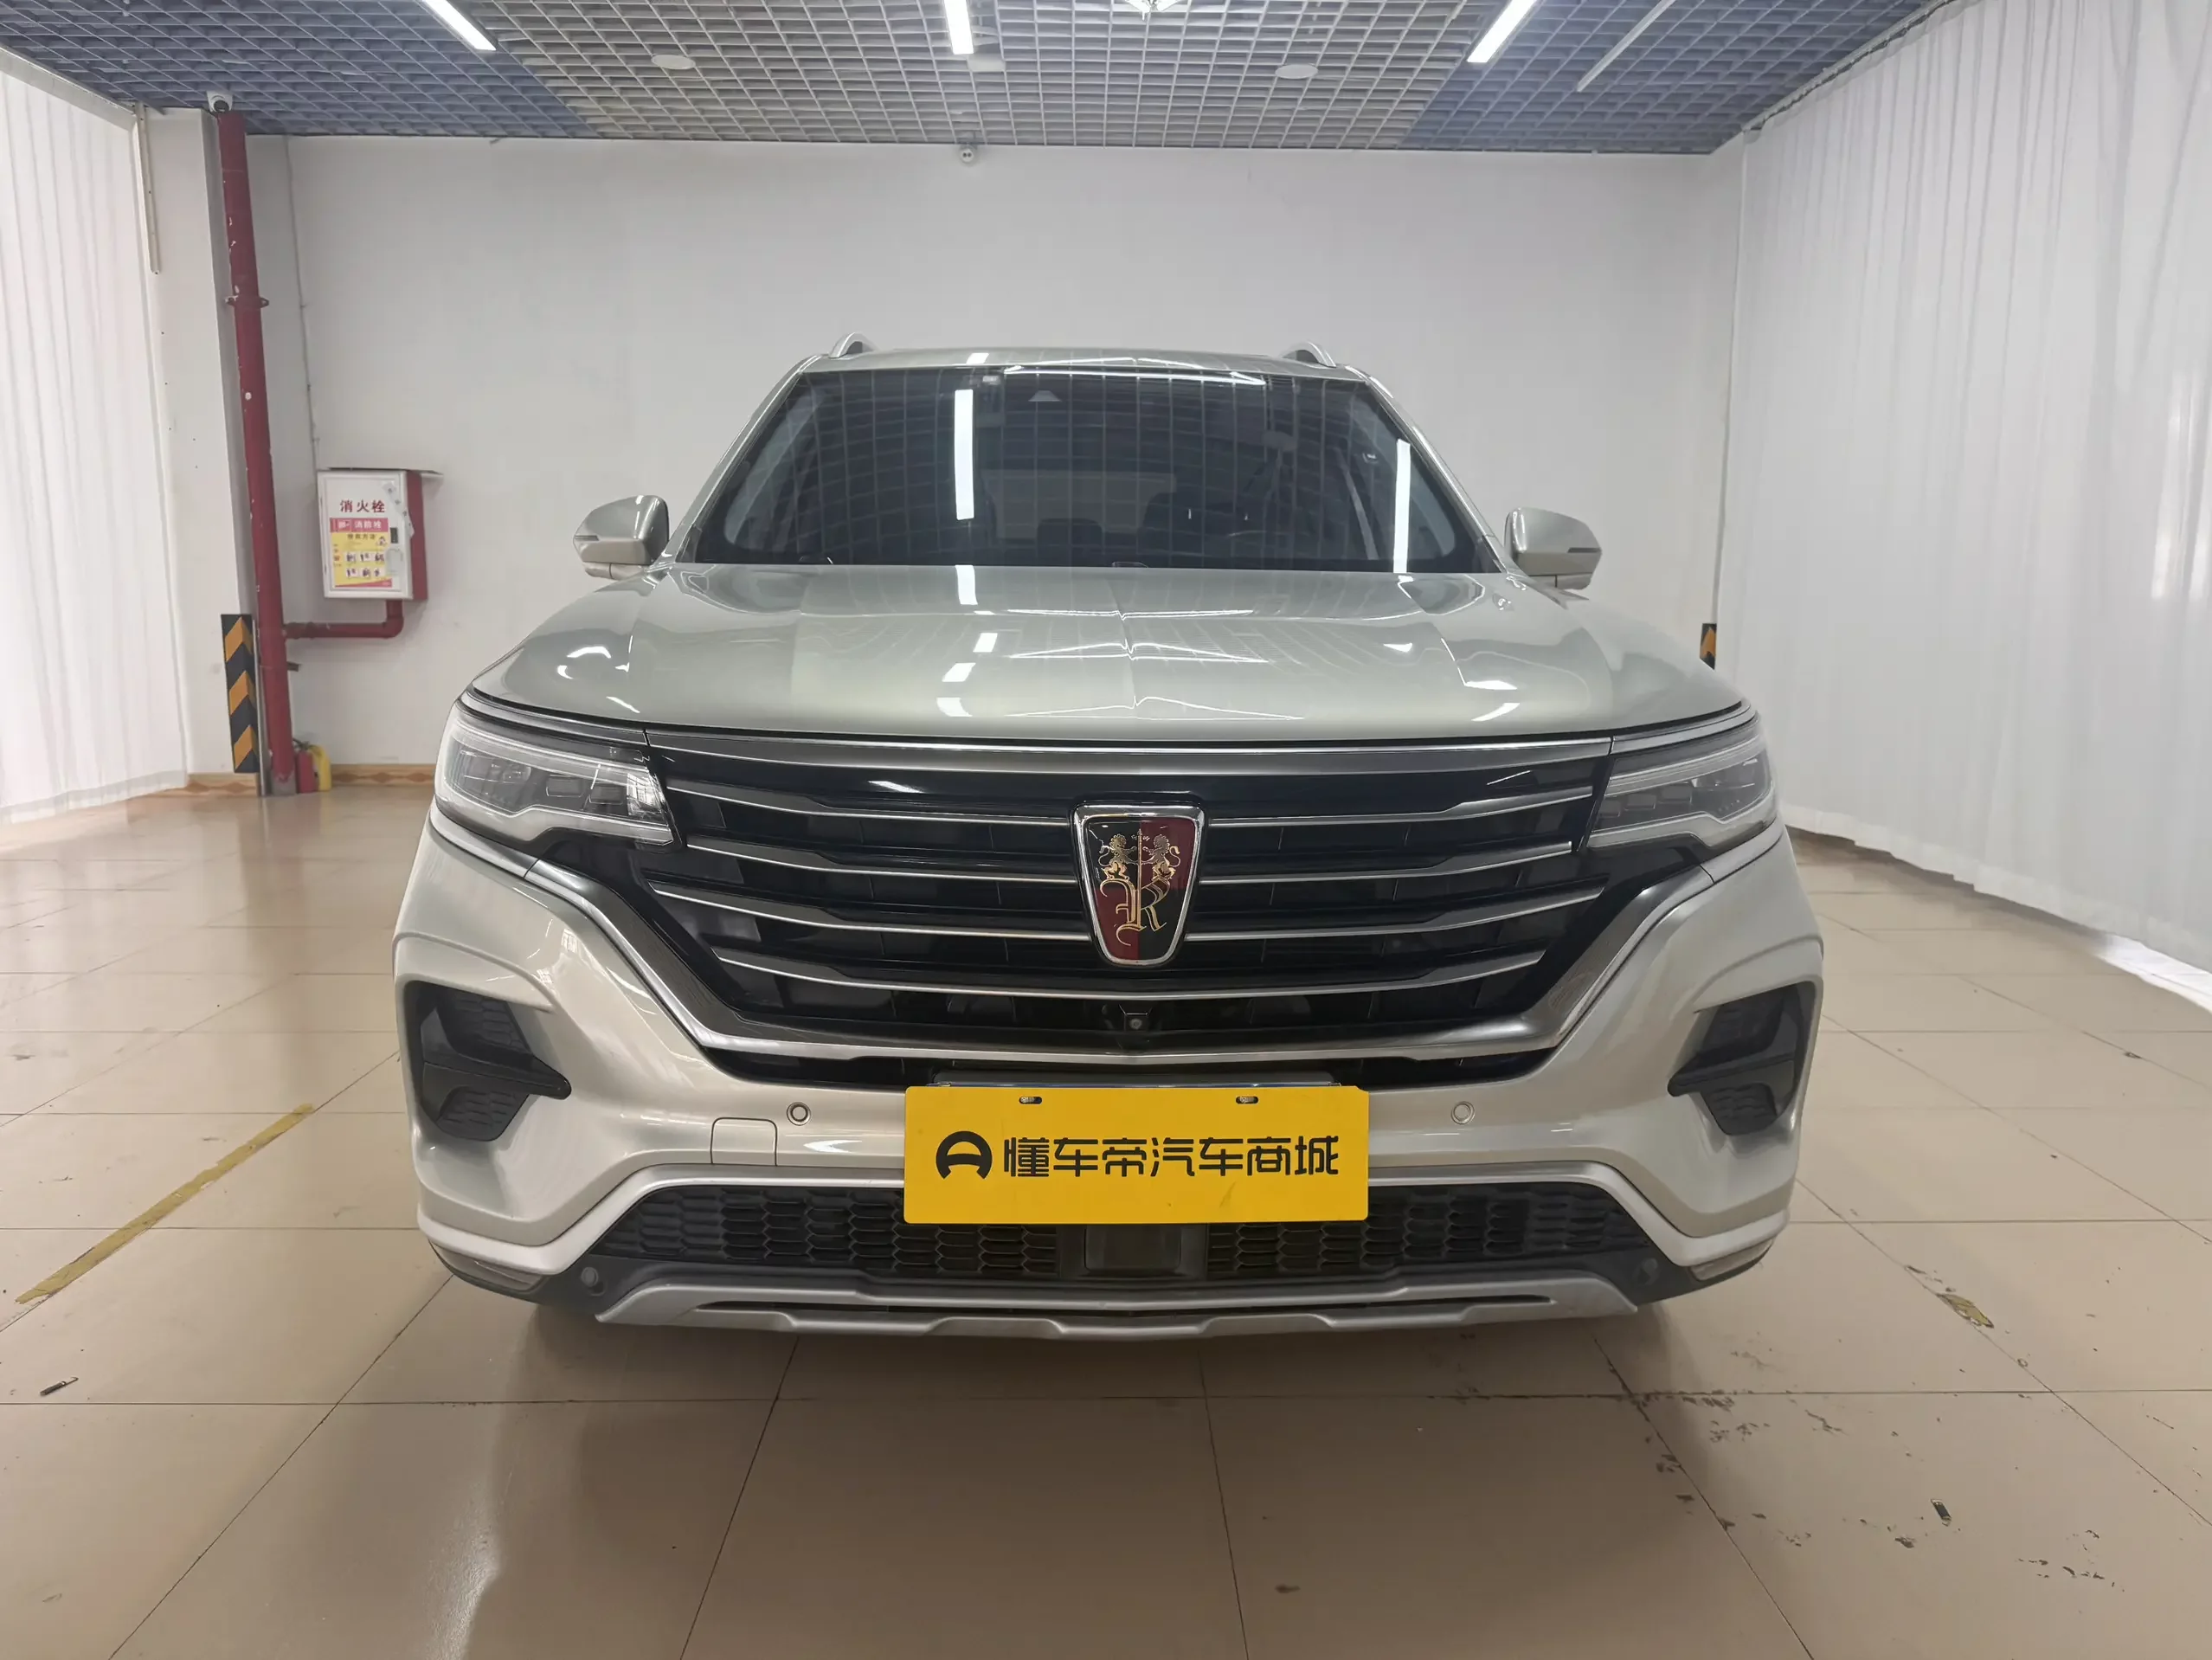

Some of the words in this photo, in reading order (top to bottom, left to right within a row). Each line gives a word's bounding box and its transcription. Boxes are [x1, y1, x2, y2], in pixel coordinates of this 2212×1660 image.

[340, 499, 386, 513] 消火栓
[1004, 1135, 1339, 1178] 懂车帝汽车商城
